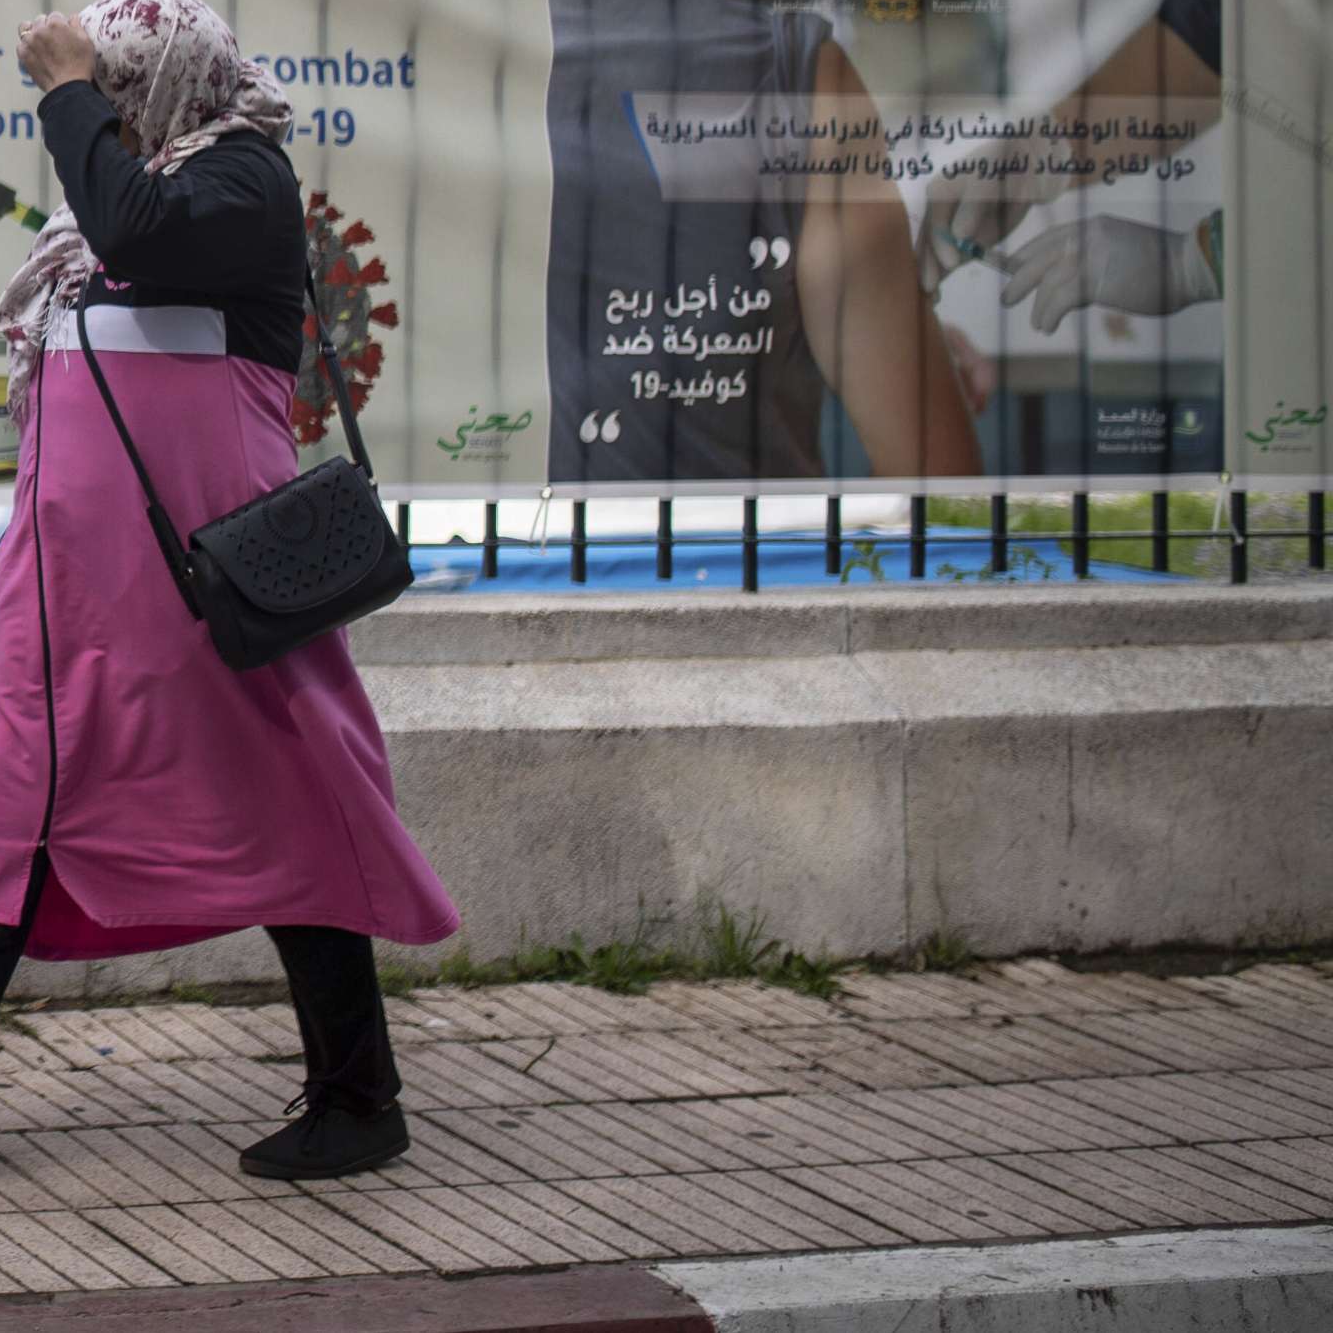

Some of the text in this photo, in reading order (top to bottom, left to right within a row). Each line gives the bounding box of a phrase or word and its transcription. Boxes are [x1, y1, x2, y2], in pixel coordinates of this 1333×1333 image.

[646, 112, 1197, 147] الحملة الوطنية للمشاركة في الدراسات السريرية
[757, 153, 858, 180] المستجد
[864, 152, 934, 181] كورونا
[941, 153, 1030, 180] لفيروس
[1102, 153, 1150, 183] لقاح
[1157, 155, 1197, 180] حول
[605, 274, 771, 324] من أجل ربح
[602, 322, 775, 361] المعركة ضد
[630, 369, 747, 405] كوفيد-19
